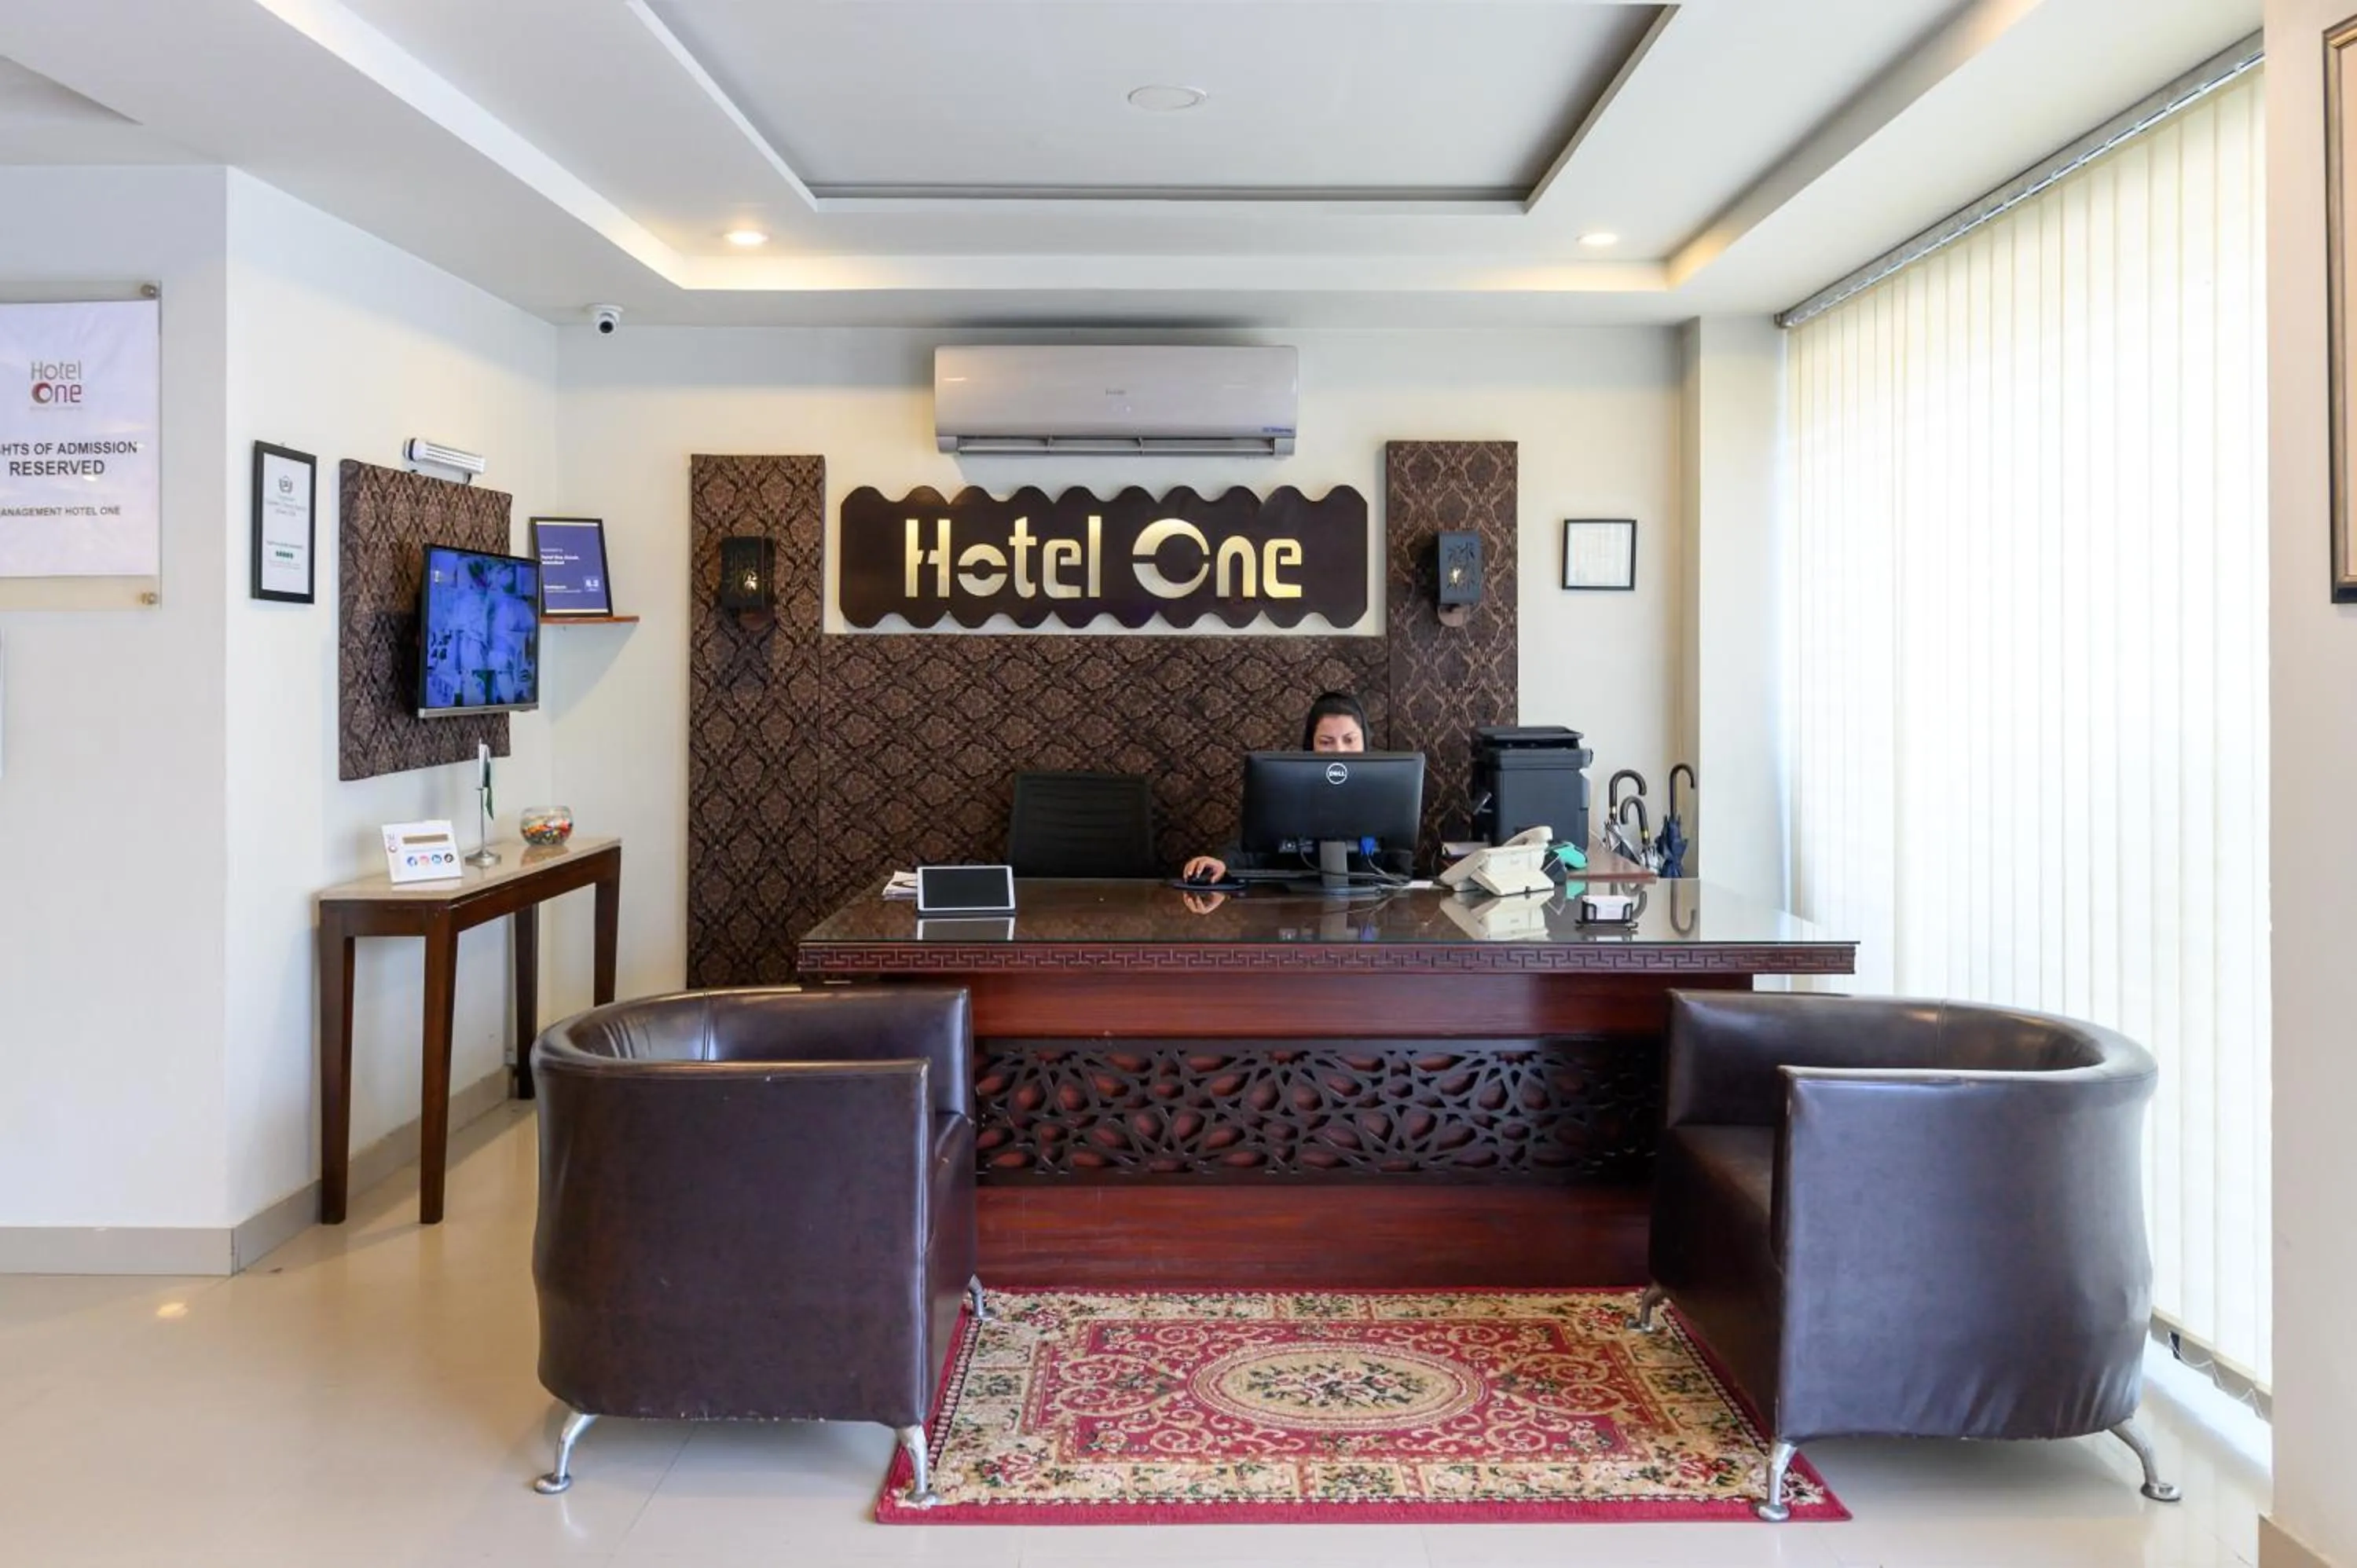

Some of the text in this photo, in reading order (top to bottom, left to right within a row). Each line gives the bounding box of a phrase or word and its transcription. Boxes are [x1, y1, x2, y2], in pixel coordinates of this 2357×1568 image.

[31, 361, 82, 380] Hotel
[31, 383, 82, 404] One
[0, 441, 137, 456] HTS OF ADMISSION
[9, 460, 104, 476] RESERVED
[0, 506, 121, 517] ANAGEMENT HOTEL ONE
[905, 515, 1302, 599] Hotel One
